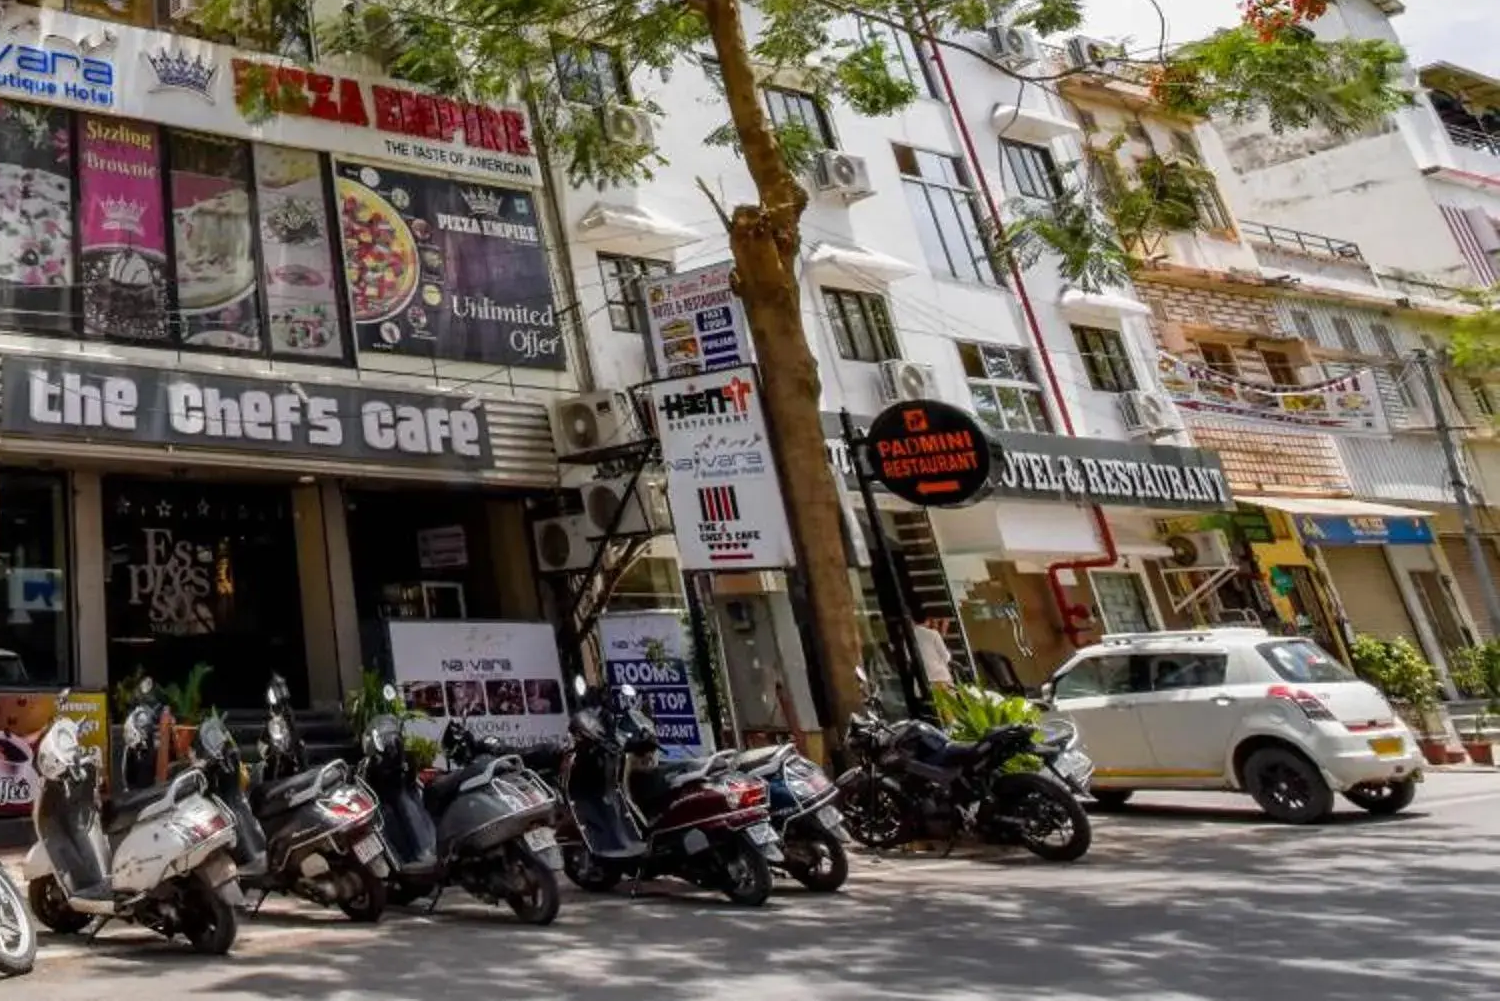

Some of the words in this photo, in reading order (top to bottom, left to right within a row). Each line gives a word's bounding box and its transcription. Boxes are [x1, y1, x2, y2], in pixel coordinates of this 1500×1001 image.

[64, 84, 114, 106] Hotel
[86, 120, 152, 151] Sizzling
[373, 85, 531, 157] EMPIRE
[384, 139, 409, 157] THE
[412, 144, 448, 165] TASTE
[450, 151, 466, 166] OF
[468, 154, 533, 178] AMERICAN
[437, 214, 480, 235] PIZZA
[482, 220, 539, 243] EMPIRE
[451, 295, 555, 328] Unlimited
[509, 329, 561, 359] Offer
[29, 369, 139, 430] the
[668, 414, 749, 431] RESTAURANT
[878, 430, 973, 458] PADMINI
[882, 450, 979, 479] RESTAURANT
[1081, 457, 1229, 503] RESTAURANT
[613, 662, 681, 684] ROOMS
[658, 692, 687, 710] TOP
